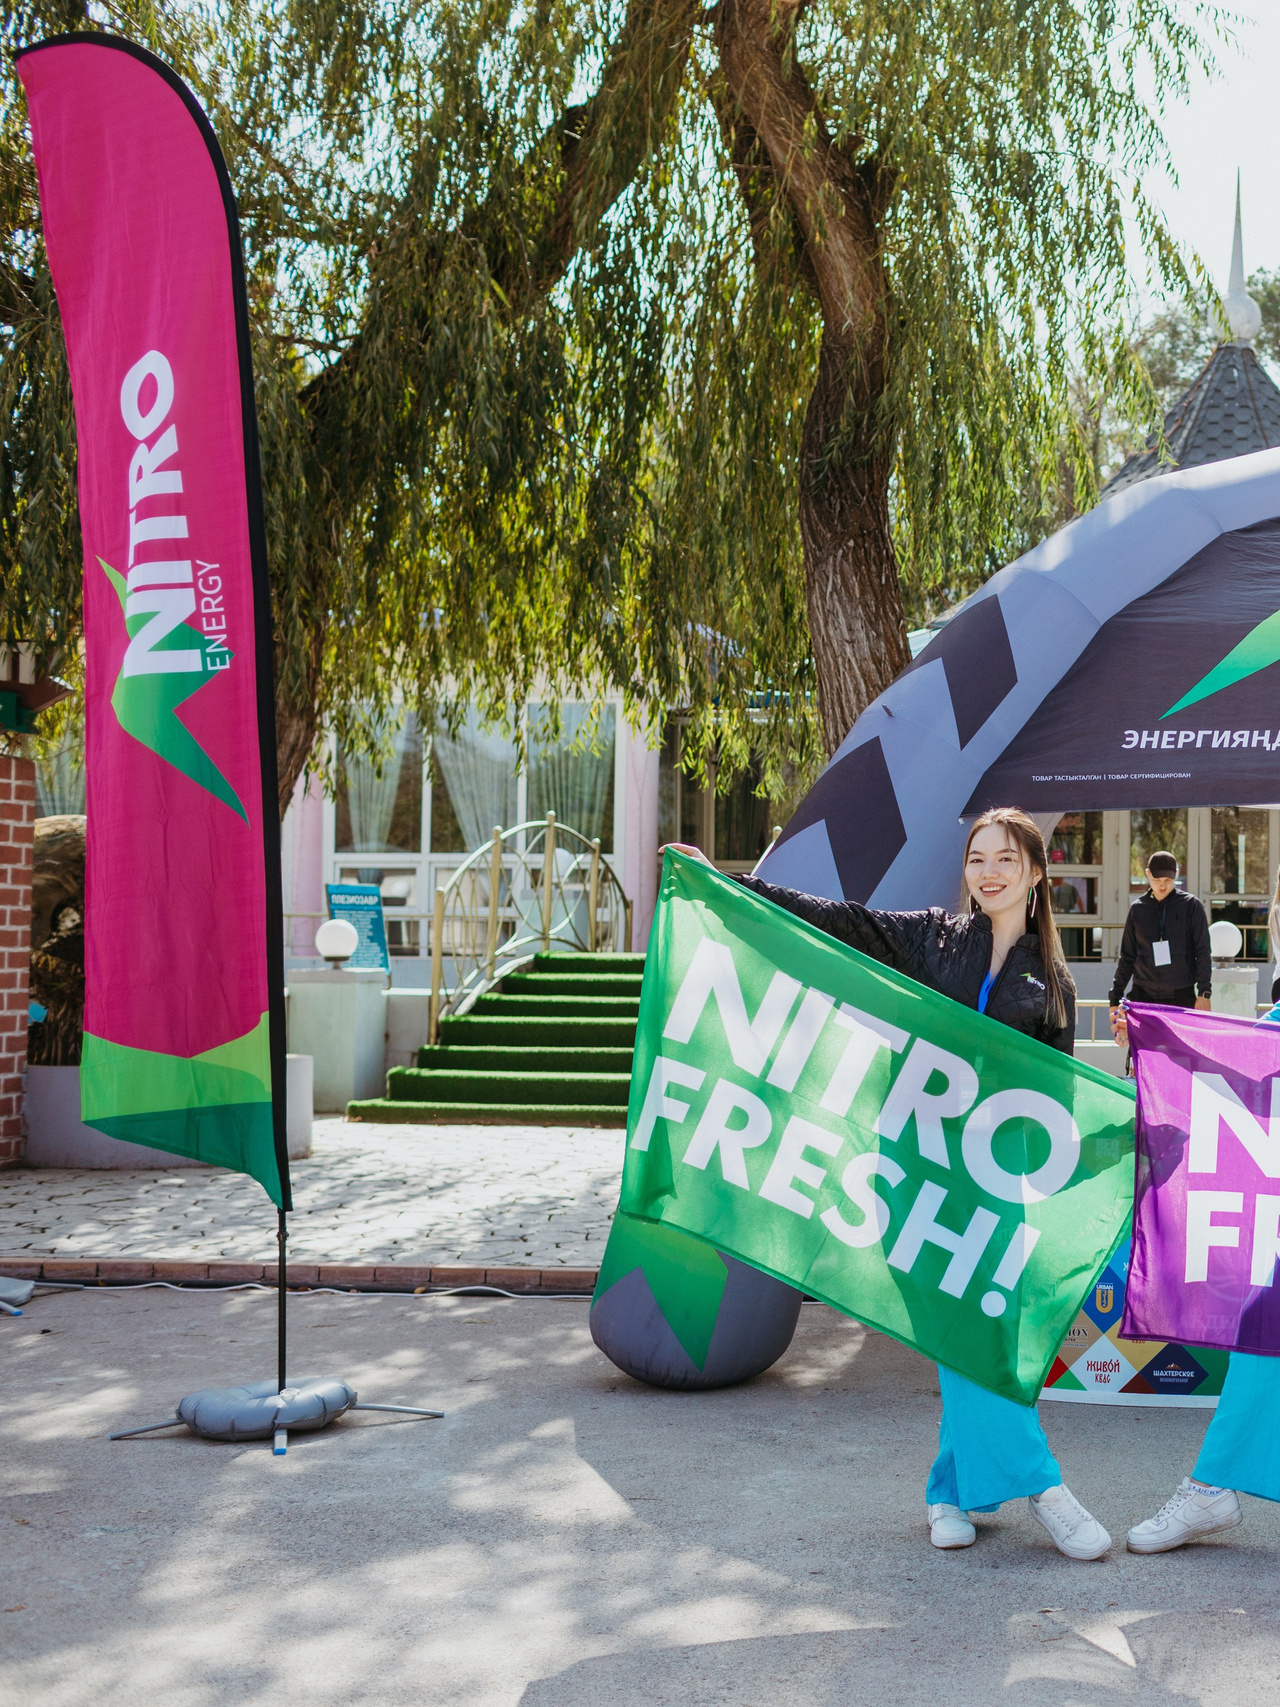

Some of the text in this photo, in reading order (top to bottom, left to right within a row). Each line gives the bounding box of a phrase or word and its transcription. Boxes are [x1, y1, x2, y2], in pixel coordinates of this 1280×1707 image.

[120, 350, 202, 678] NITRO
[196, 559, 231, 671] ENERGY
[1130, 772, 1191, 780] СЕРТИФИЦИРОВАН
[331, 894, 379, 905] ПЛЕЗИОЗАВР
[662, 935, 1081, 1204] NITRO
[630, 1055, 1041, 1318] FRESH!
[1095, 1373, 1111, 1383] КВАС
